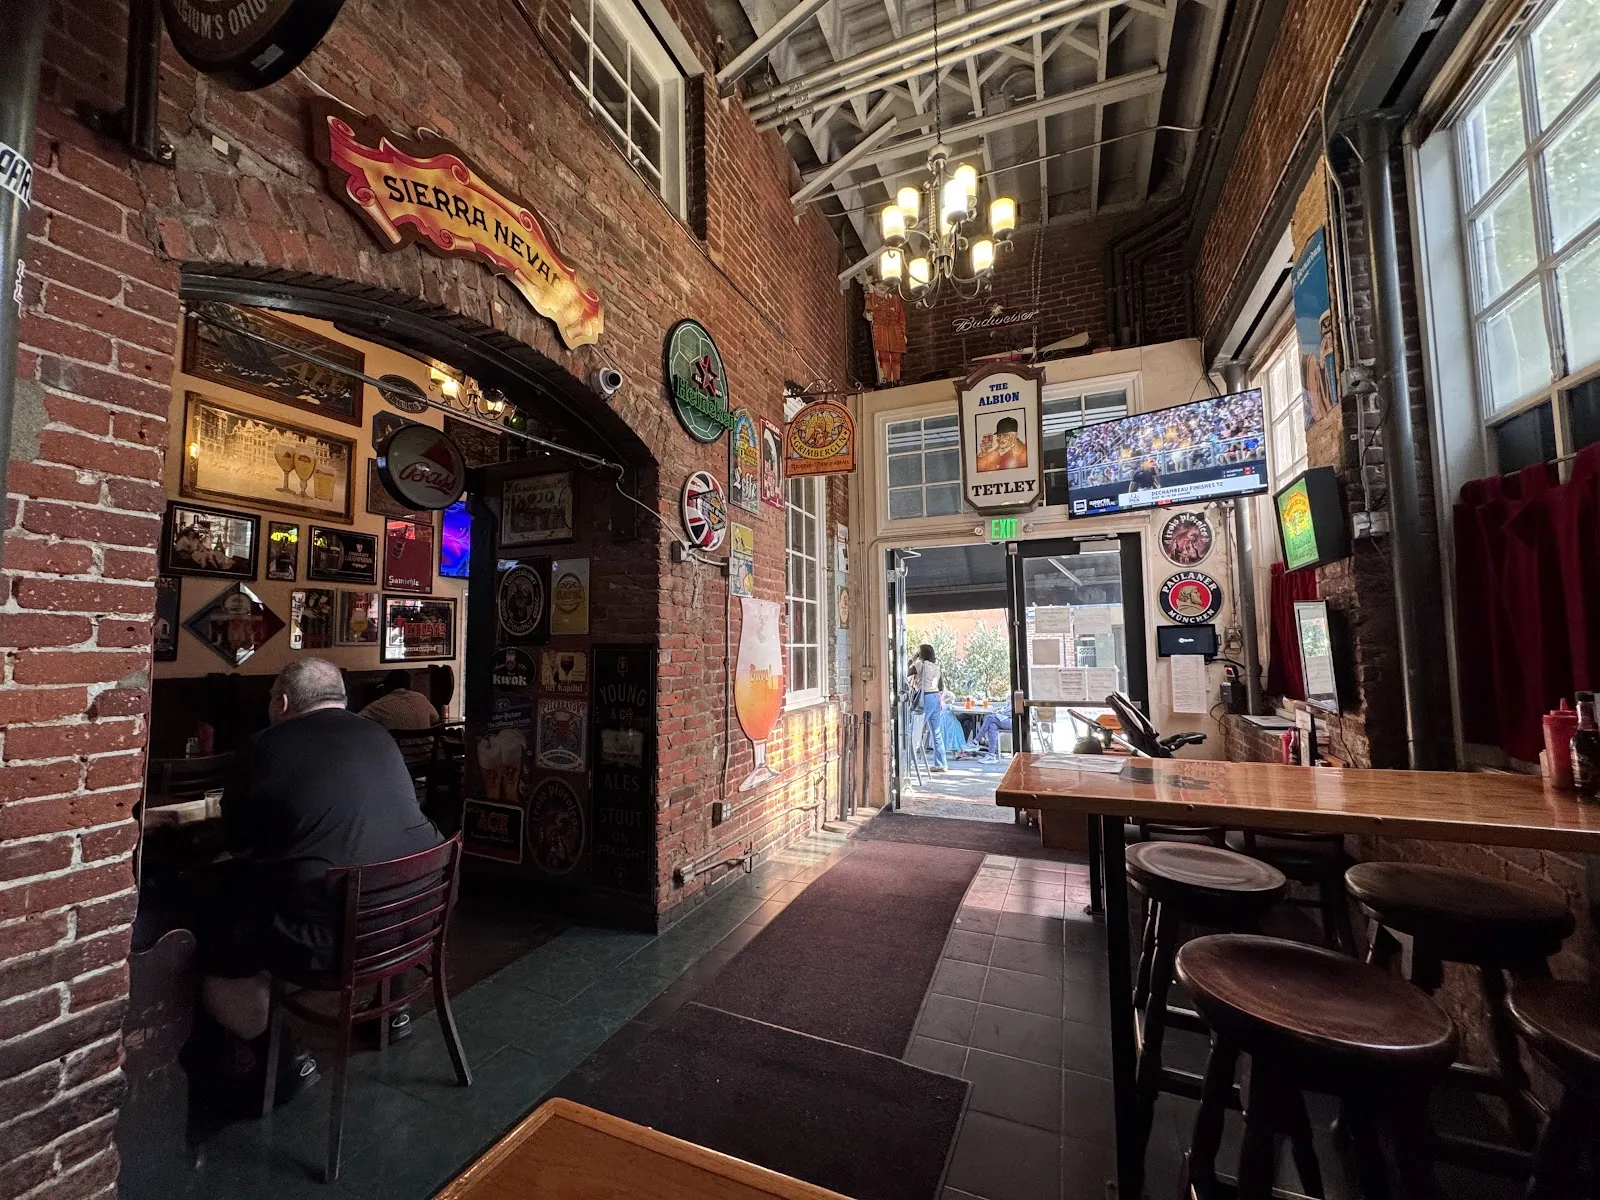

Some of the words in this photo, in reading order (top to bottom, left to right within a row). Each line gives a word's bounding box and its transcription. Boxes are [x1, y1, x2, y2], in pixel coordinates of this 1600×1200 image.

[383, 175, 489, 232] SIERRA
[952, 311, 1040, 333] Budweiser
[989, 382, 1008, 392] THE
[673, 373, 737, 431] Heineken
[978, 391, 1020, 407] ALBION
[793, 435, 846, 457] GRIMBERGEN
[399, 462, 457, 491] Bass
[733, 466, 757, 500] Leffe
[971, 479, 1036, 497] TETLEY
[1151, 485, 1189, 497] DECHAMBEAU
[1190, 482, 1215, 492] FINISHES
[991, 518, 1018, 539] EXIT
[1161, 572, 1218, 594] PAULANER
[1167, 608, 1215, 624] MÜNCHEN
[492, 674, 528, 686] kwak
[598, 683, 648, 707] YOUNG
[603, 770, 641, 793] ALES
[599, 805, 643, 829] STOUT
